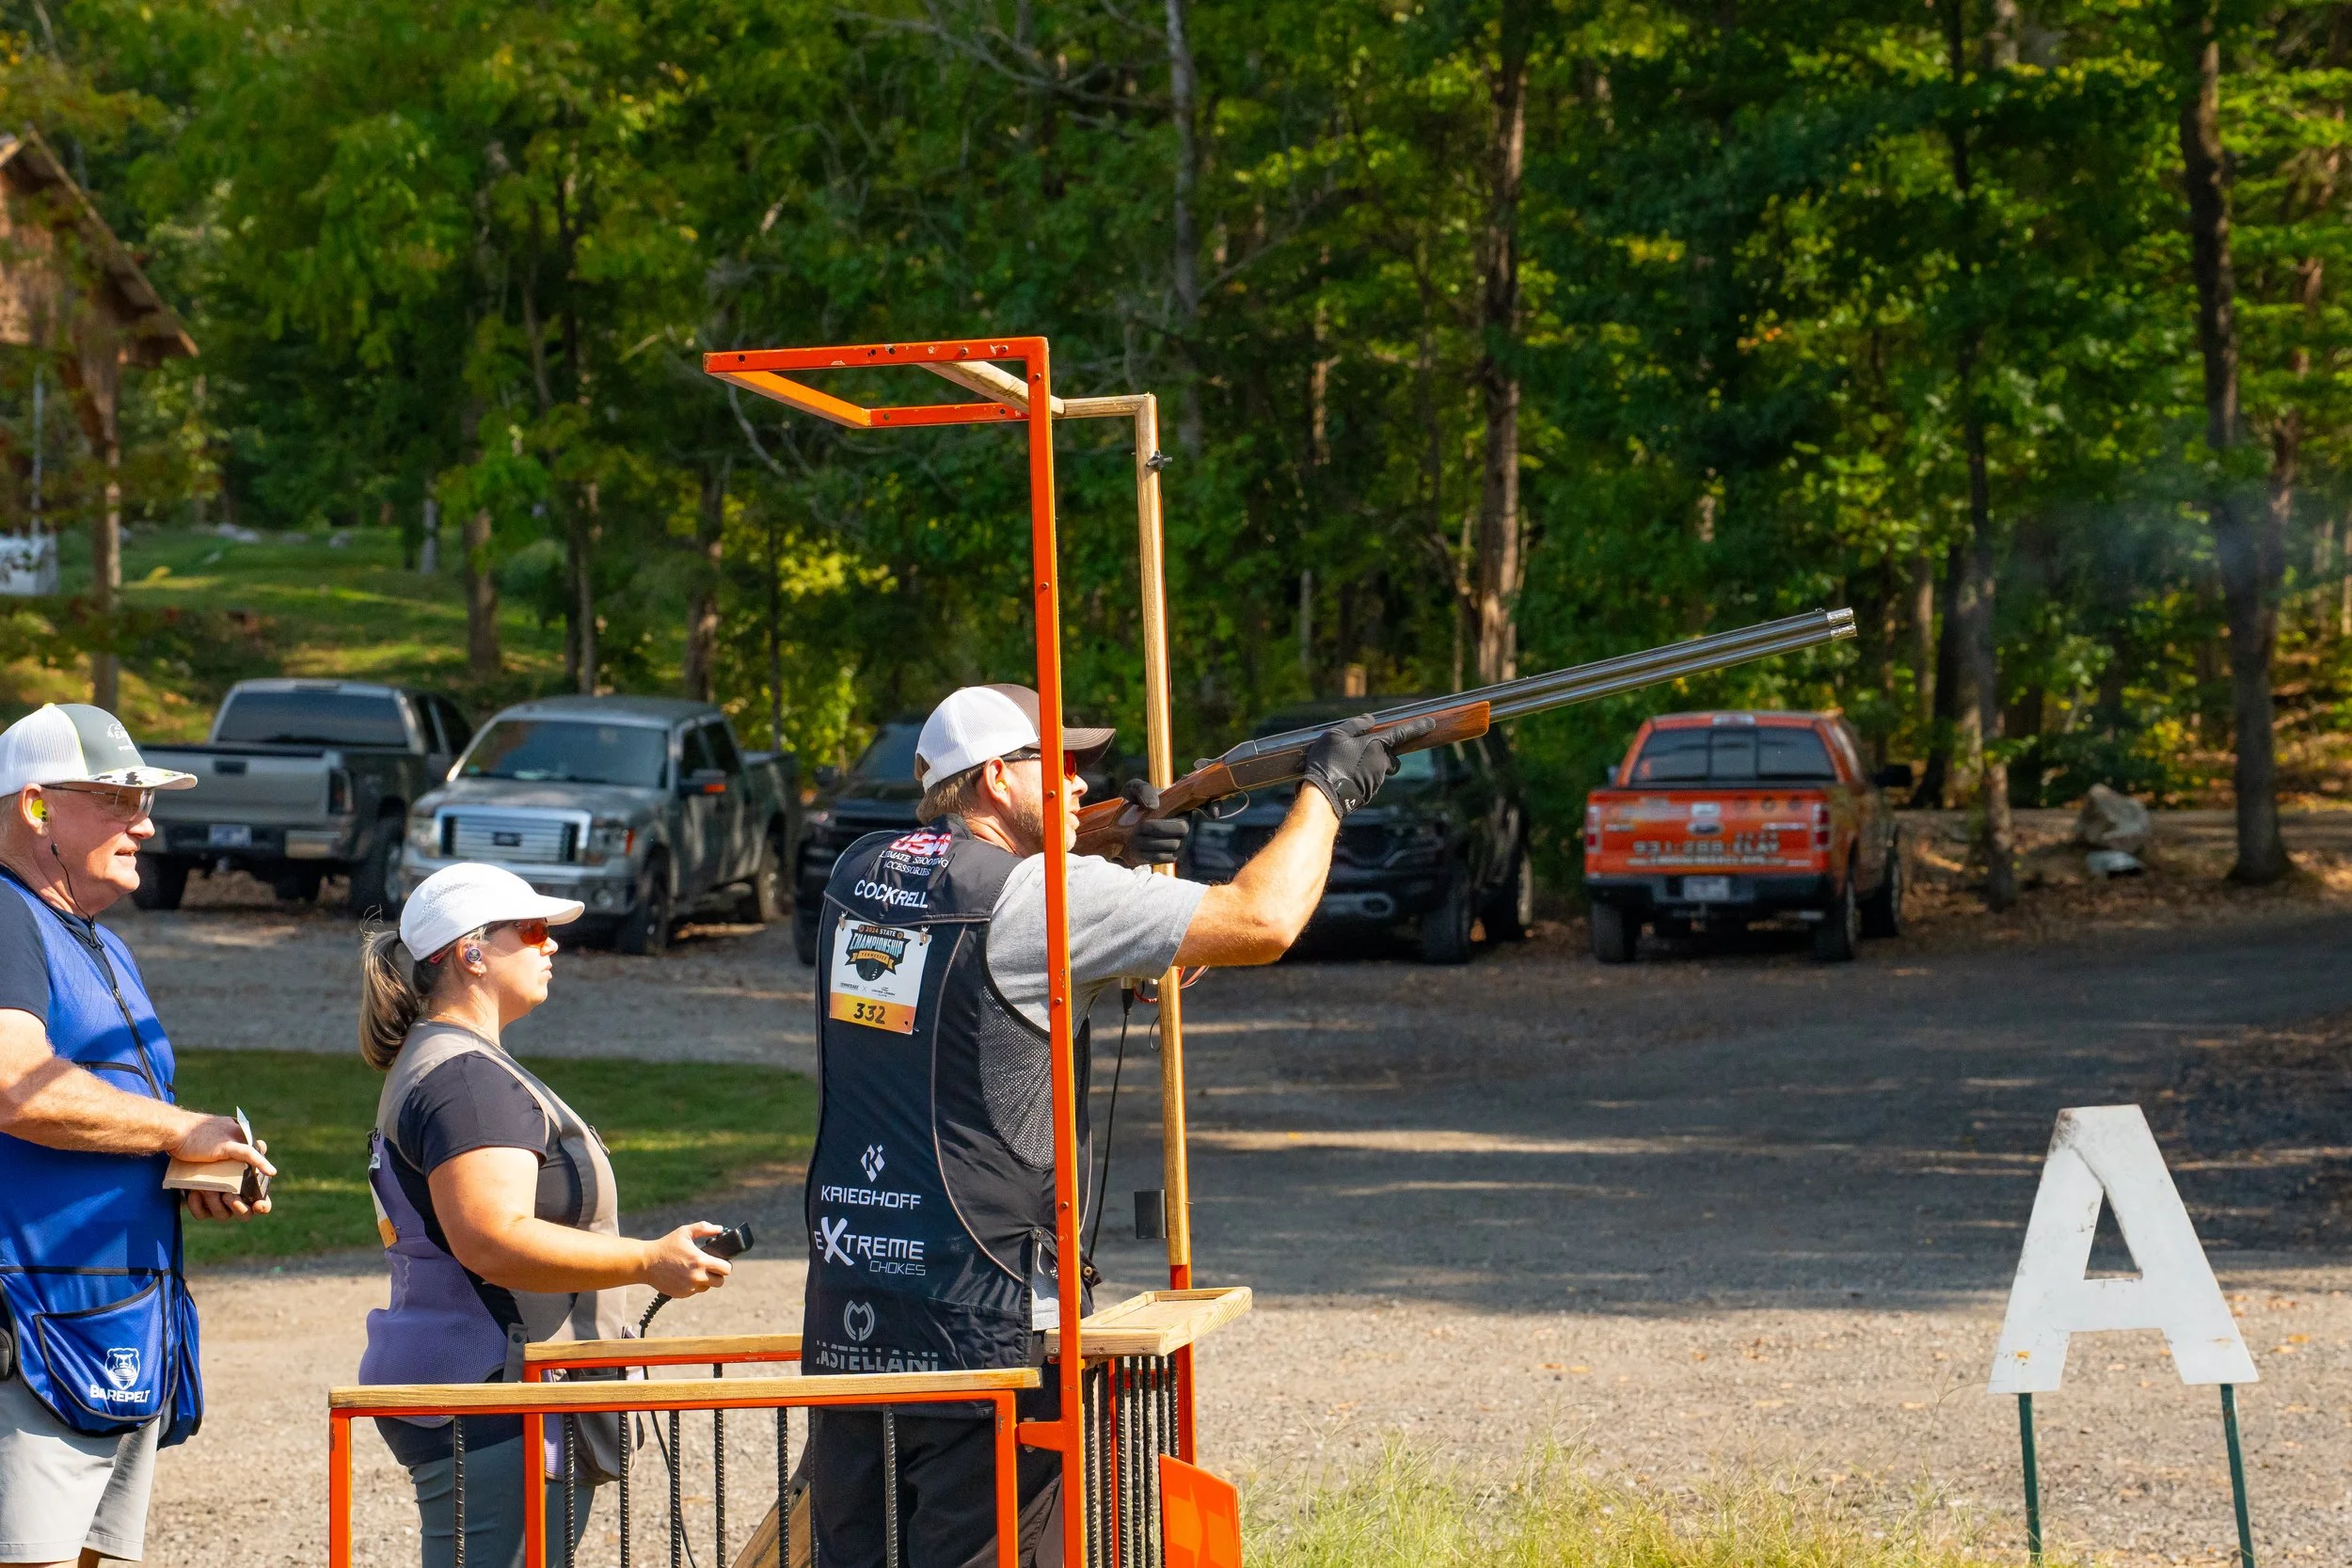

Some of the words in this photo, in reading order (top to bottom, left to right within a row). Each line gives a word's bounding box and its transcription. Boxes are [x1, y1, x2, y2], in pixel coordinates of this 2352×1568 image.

[889, 832, 952, 856] USA
[854, 879, 929, 909] COCKRELL
[865, 926, 879, 934] 2024
[880, 928, 897, 937] STATE
[850, 933, 904, 958] CHAMPIONSHIP
[853, 1003, 885, 1024] 332
[820, 1185, 921, 1210] KRIEGHOFF
[1987, 1104, 2259, 1393] A
[869, 1260, 926, 1276] CHOKES
